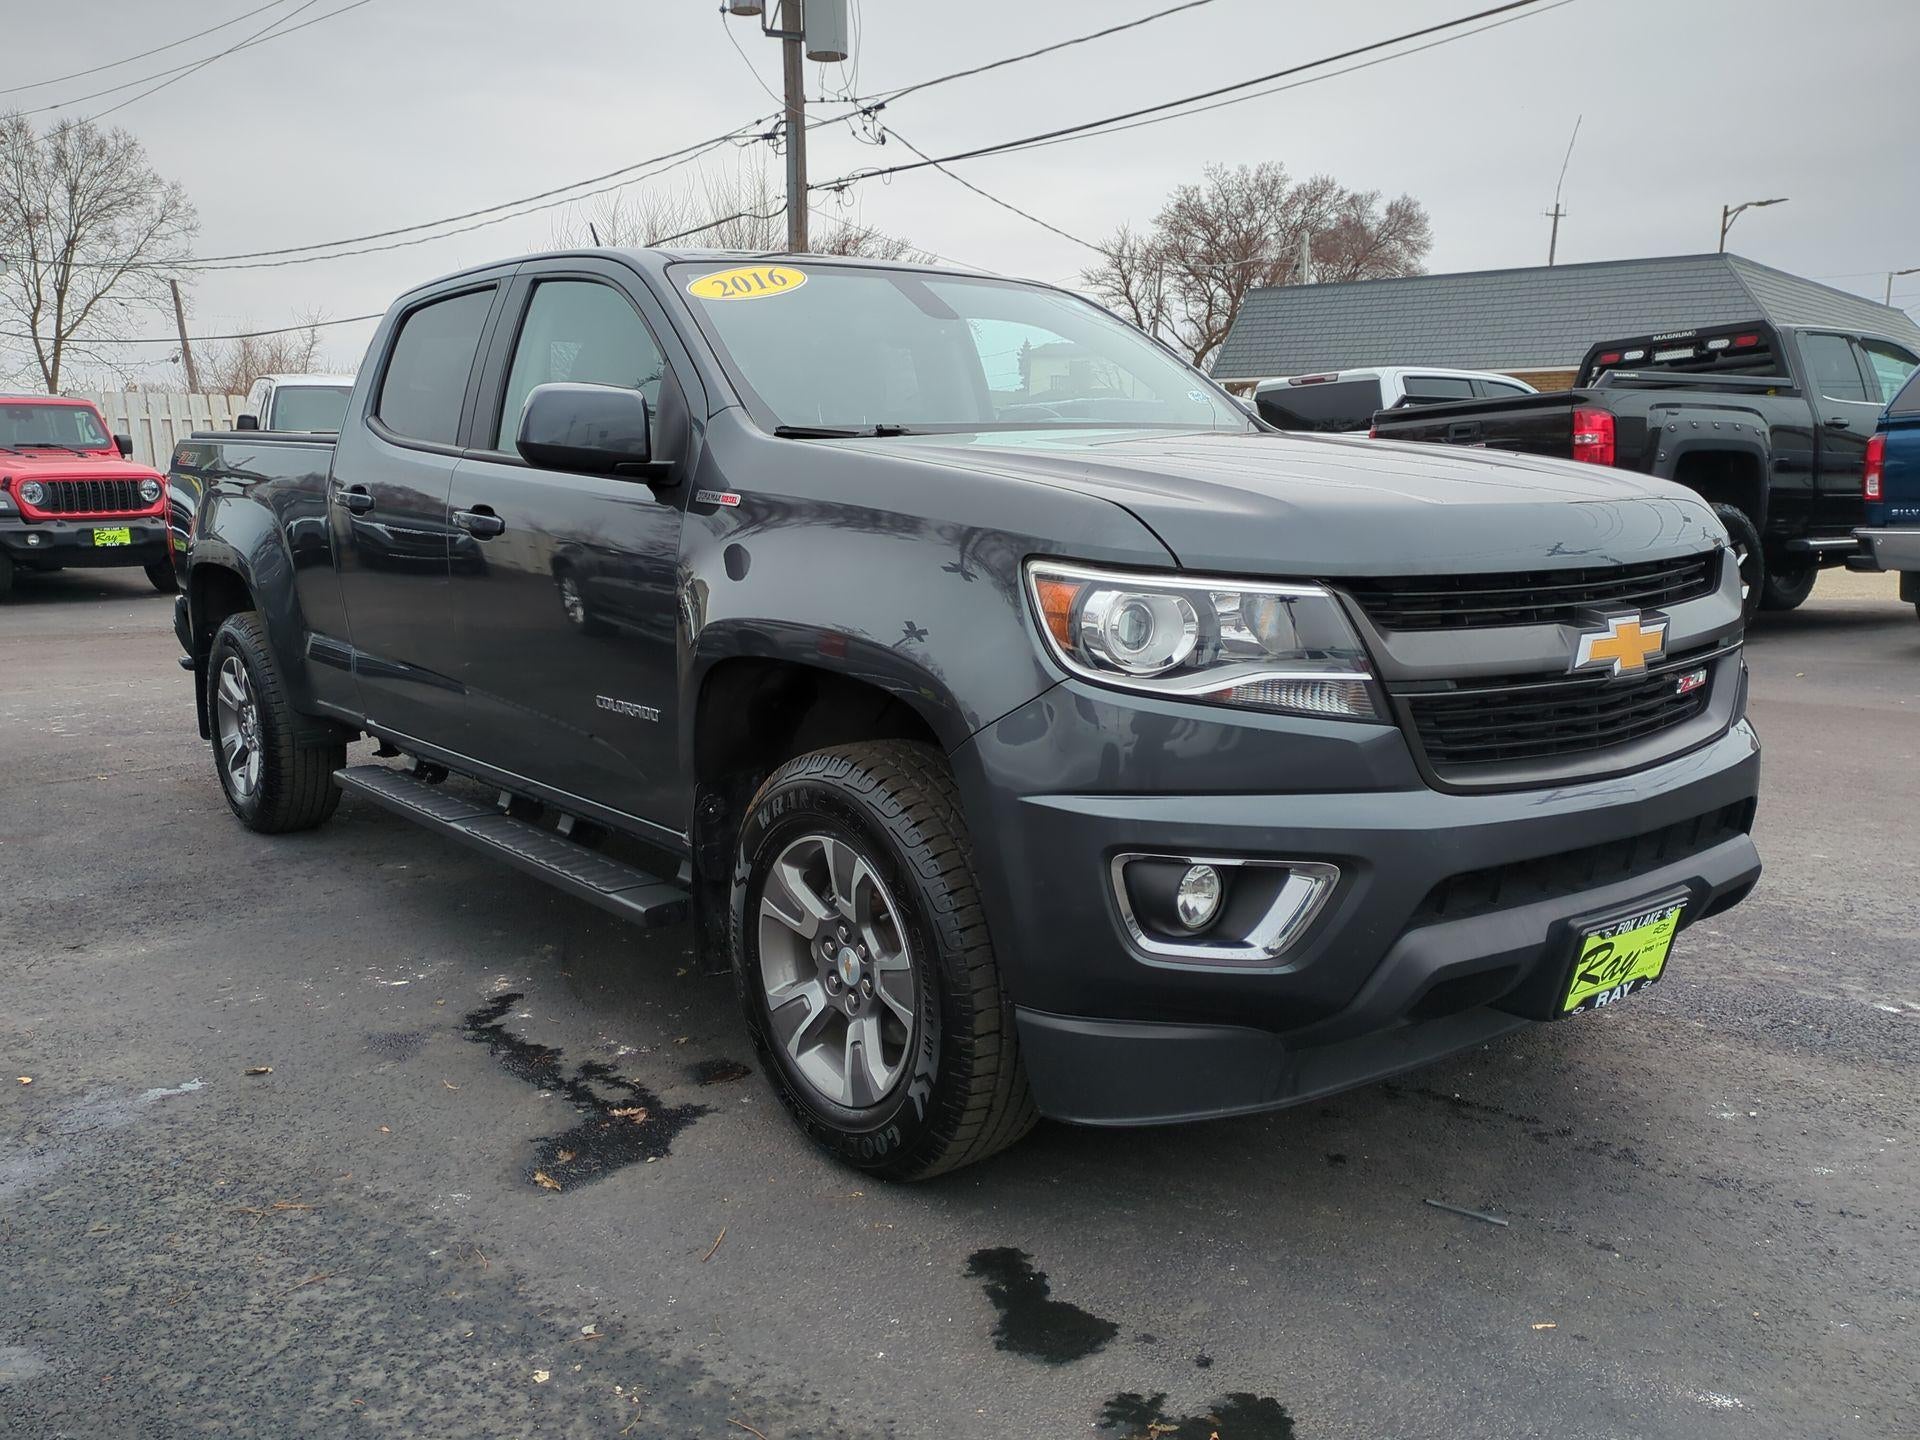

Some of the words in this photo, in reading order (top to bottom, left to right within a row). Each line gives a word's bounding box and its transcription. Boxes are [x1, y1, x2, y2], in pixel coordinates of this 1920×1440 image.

[711, 268, 787, 297] 2016
[1653, 331, 1693, 341] MAGNUM
[1679, 669, 1706, 693] Z71
[596, 695, 659, 722] COLORADO
[1616, 918, 1637, 936] FOX
[1636, 910, 1663, 928] LAKE
[1570, 941, 1641, 995] Ray
[1595, 980, 1635, 1009] RAY
